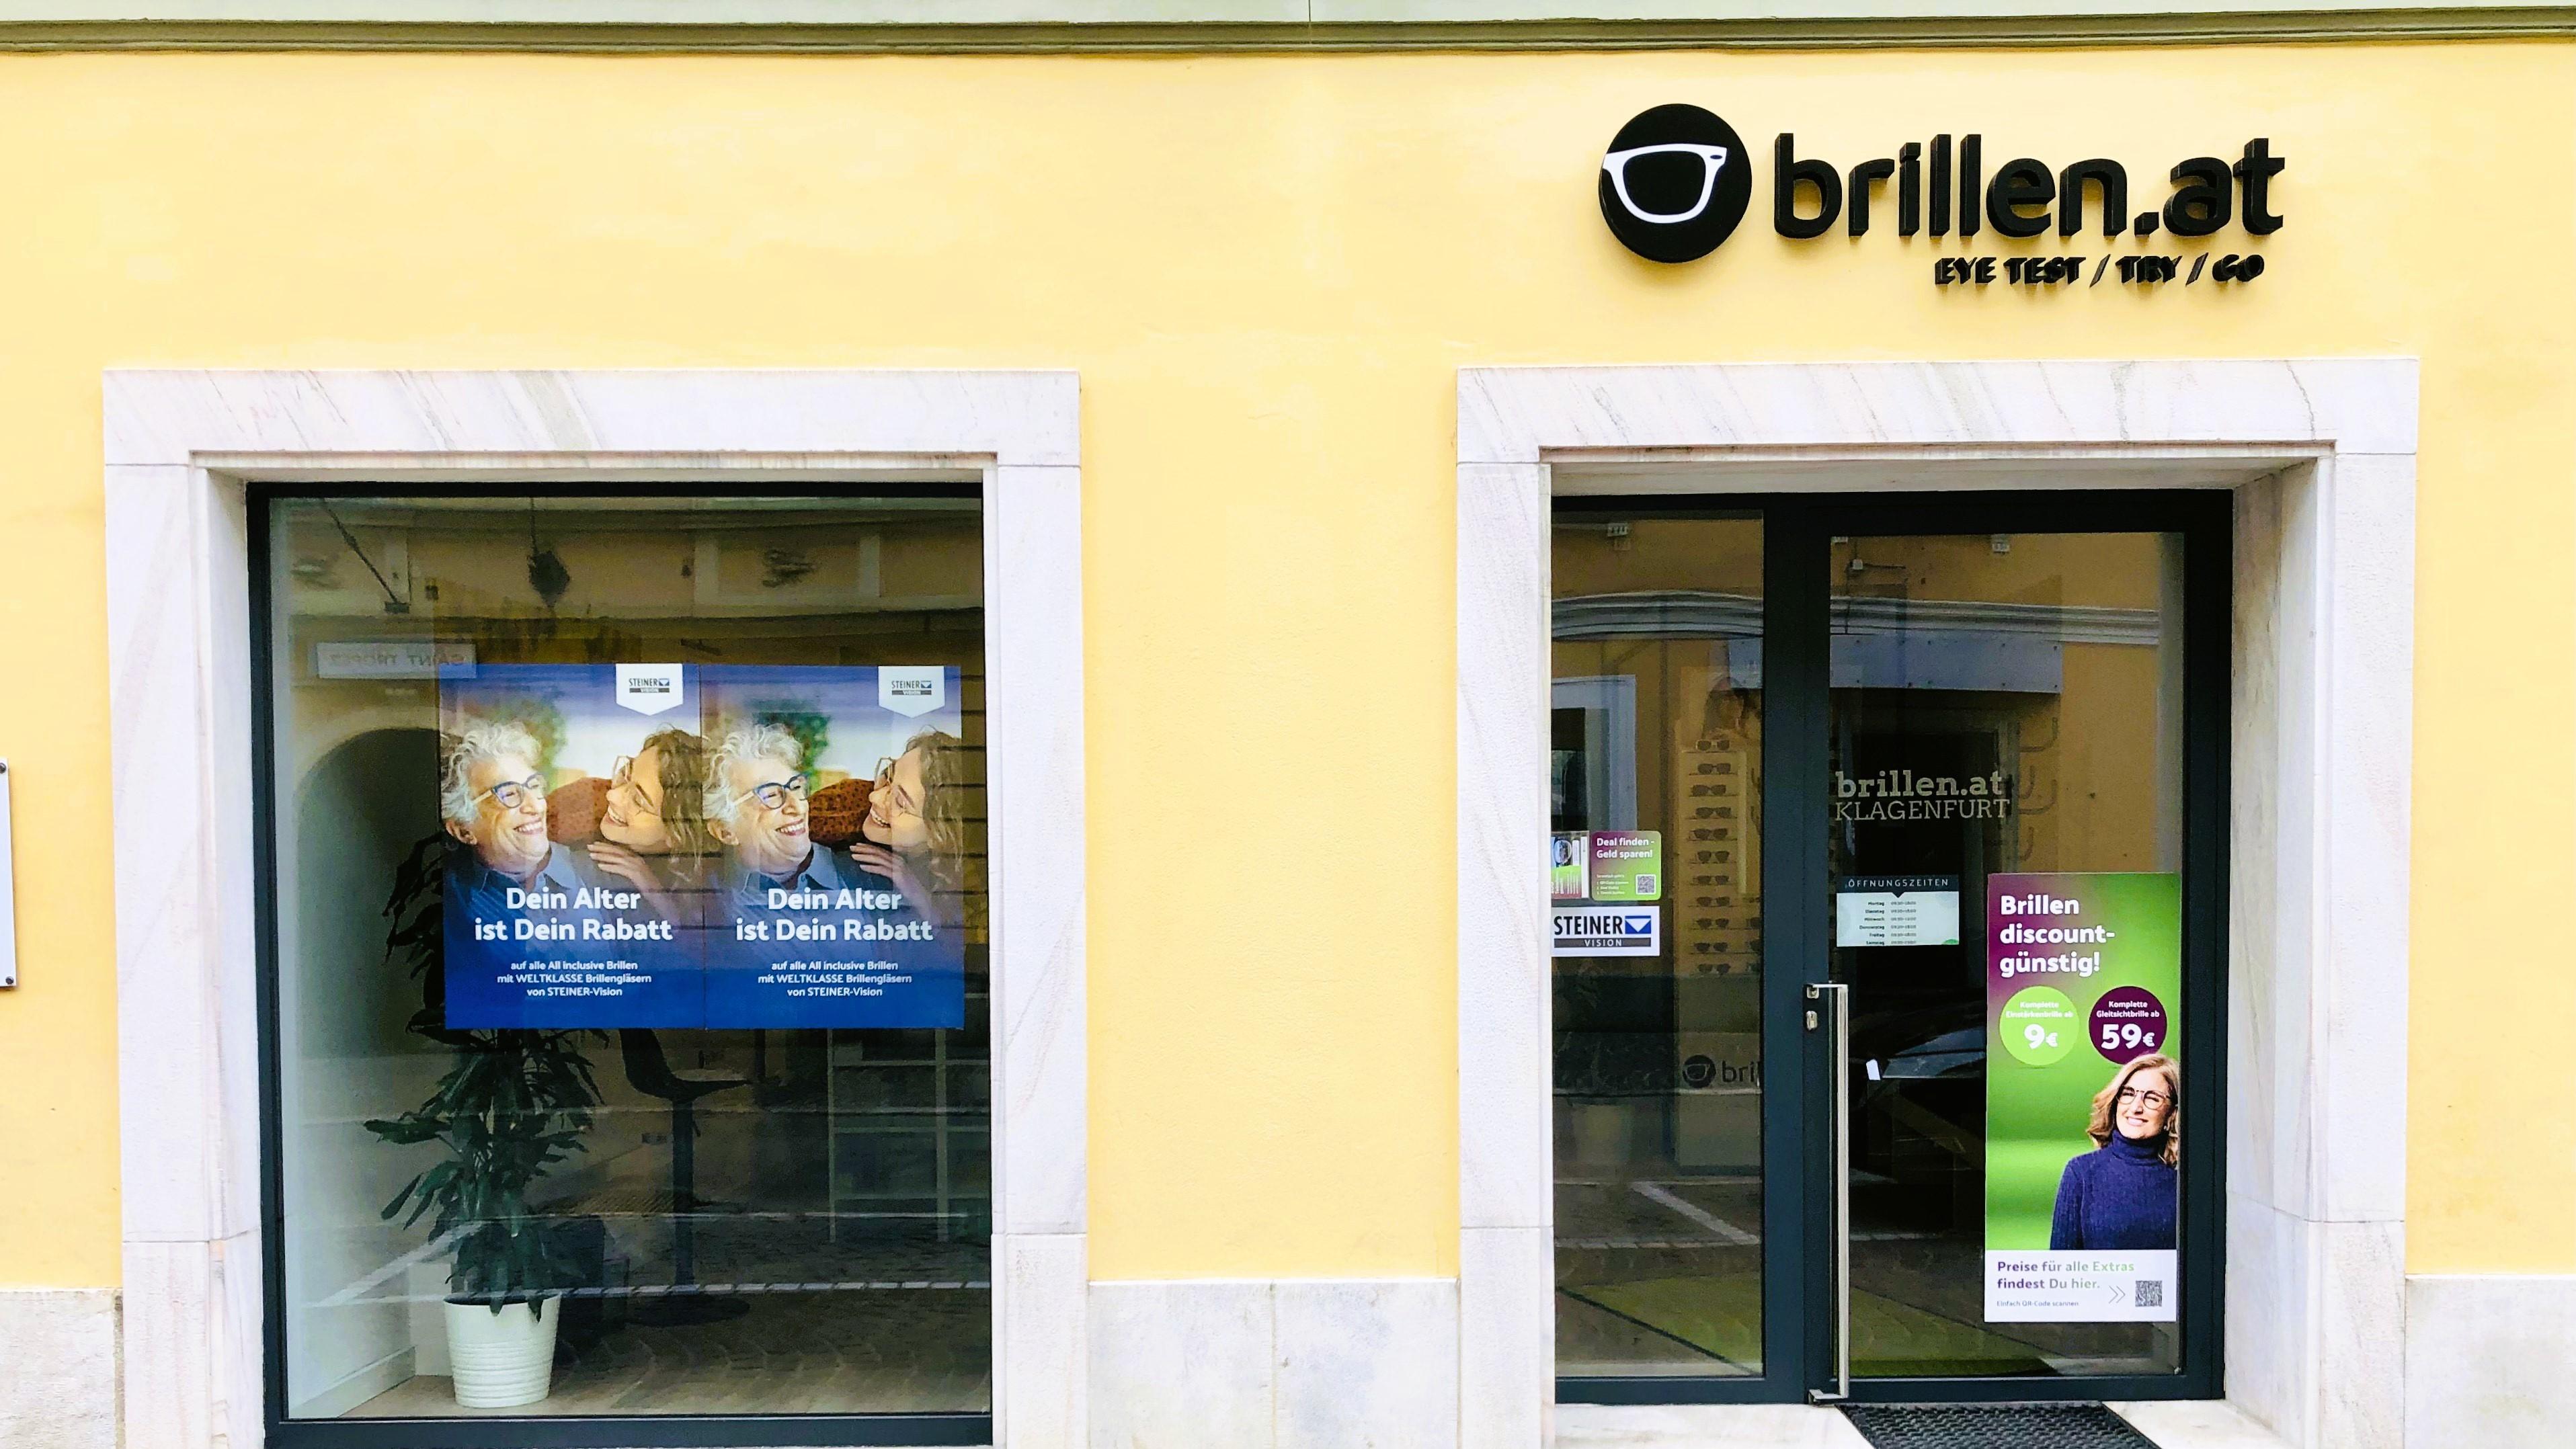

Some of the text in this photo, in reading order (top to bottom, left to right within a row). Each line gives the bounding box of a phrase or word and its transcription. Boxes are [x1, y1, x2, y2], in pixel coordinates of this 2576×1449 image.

[1774, 133, 2285, 238] brillen.at
[1935, 257, 1997, 284] EYE
[2003, 257, 2084, 284] TEST
[2116, 257, 2182, 284] TRY
[2212, 253, 2265, 282] GO
[629, 678, 657, 686] STEINER
[1835, 770, 2002, 798] brillen.at
[1835, 799, 2010, 821] KLAGENFURT
[1597, 838, 1617, 846] Deal
[1619, 837, 1649, 845] finden
[1597, 850, 1652, 860] Geld sparen!
[1848, 878, 1949, 888] ÖFFNUNGSZEITEN
[506, 886, 641, 909] Dein Alter
[767, 886, 902, 909] Dein Alter
[2001, 894, 2079, 915] Brillen
[475, 918, 673, 941] ist Dein Rabatt
[736, 918, 933, 941] ist Dein Rabatt
[1554, 916, 1623, 935] STEINER
[2000, 923, 2115, 944] discount-
[511, 961, 637, 970] auf alle All inclusive Brillen
[772, 961, 898, 970] auf alle All inclusive Brillen
[2000, 951, 2099, 977] günstig!
[497, 974, 651, 985] mit WELTKLASSE Brillengläsern
[758, 974, 912, 985] mit WELTKLASSE Brillengläsern
[548, 987, 622, 997] STEINER-Vision
[808, 987, 883, 997] STEINER-Vision
[2109, 1001, 2148, 1009] Komplette
[2024, 1024, 2058, 1049] 9€
[2101, 1024, 2155, 1049] 59€
[1722, 1059, 1760, 1082] bri
[1998, 1261, 2134, 1272] Preise für alle Extras
[1997, 1278, 2100, 1289] findest Du hier.
